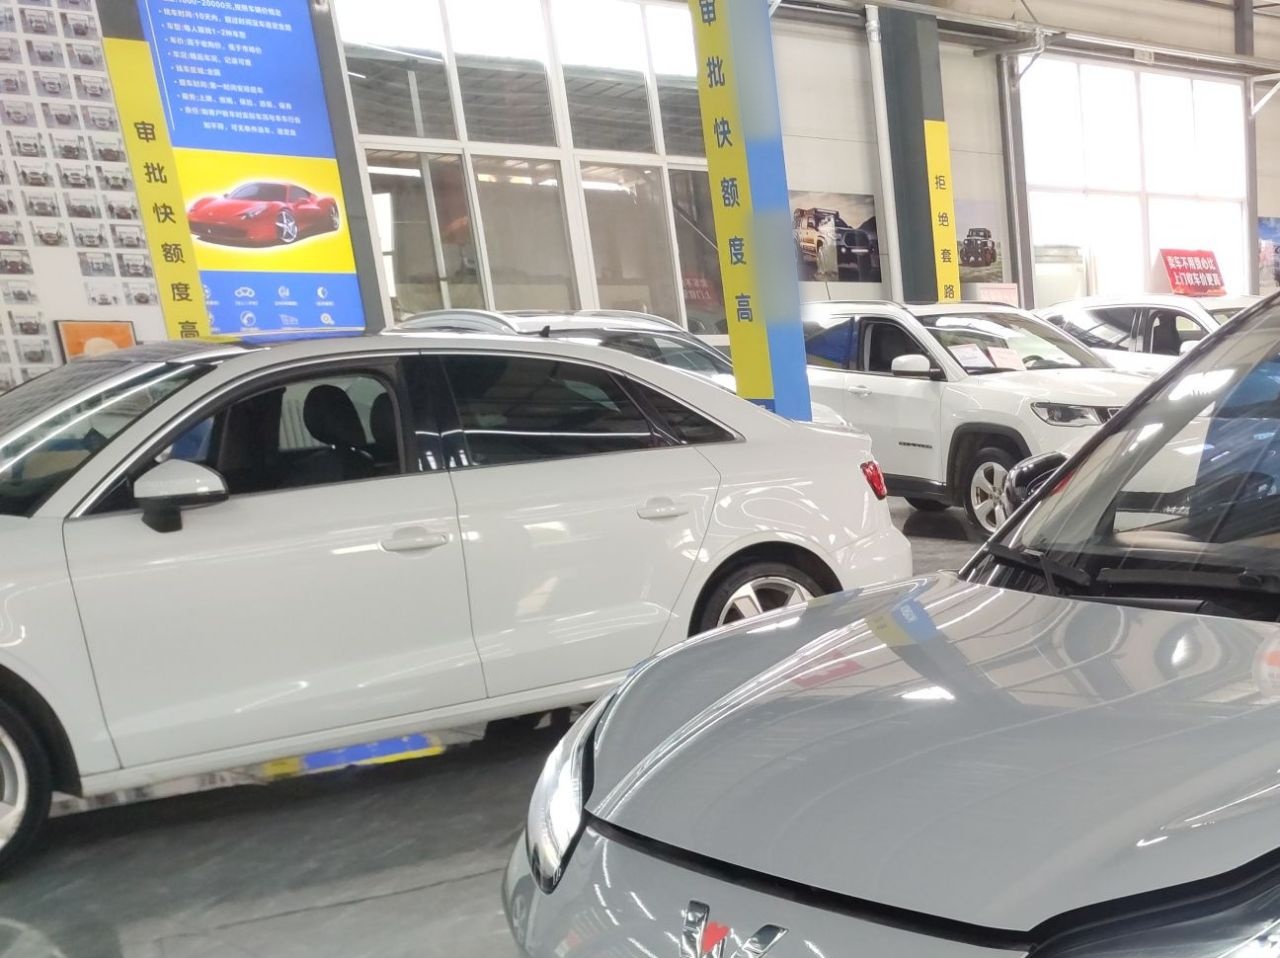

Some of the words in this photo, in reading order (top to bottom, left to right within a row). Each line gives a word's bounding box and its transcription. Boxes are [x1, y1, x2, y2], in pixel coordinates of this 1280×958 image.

[133, 121, 200, 339] 审批快额度高
